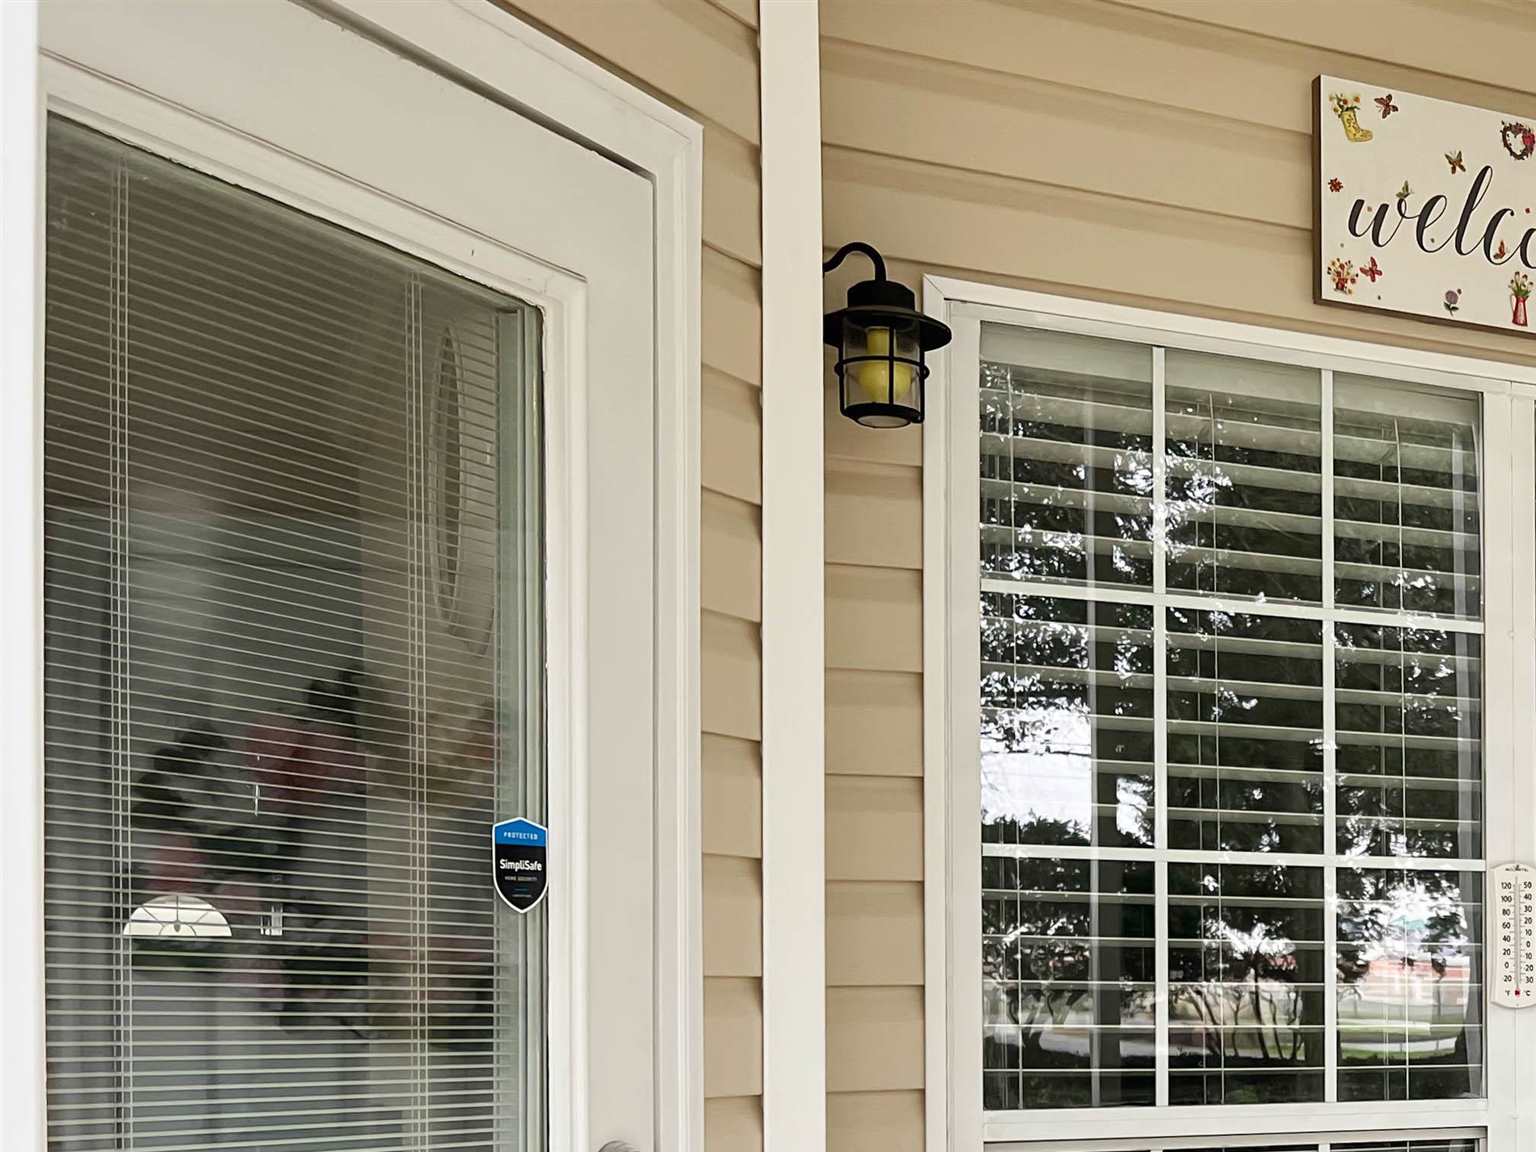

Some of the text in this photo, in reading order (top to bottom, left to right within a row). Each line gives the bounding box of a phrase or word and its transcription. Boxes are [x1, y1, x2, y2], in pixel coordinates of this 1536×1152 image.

[503, 831, 538, 840] PROTECTED
[499, 858, 542, 872] SimpliSafe
[1501, 882, 1512, 890] 120
[1523, 881, 1532, 889] 50
[1501, 895, 1512, 903] 100
[1502, 908, 1511, 916] 80
[1524, 905, 1533, 913] 30
[1502, 921, 1511, 929] 60
[1524, 917, 1533, 925] 20
[1503, 948, 1511, 956] 20
